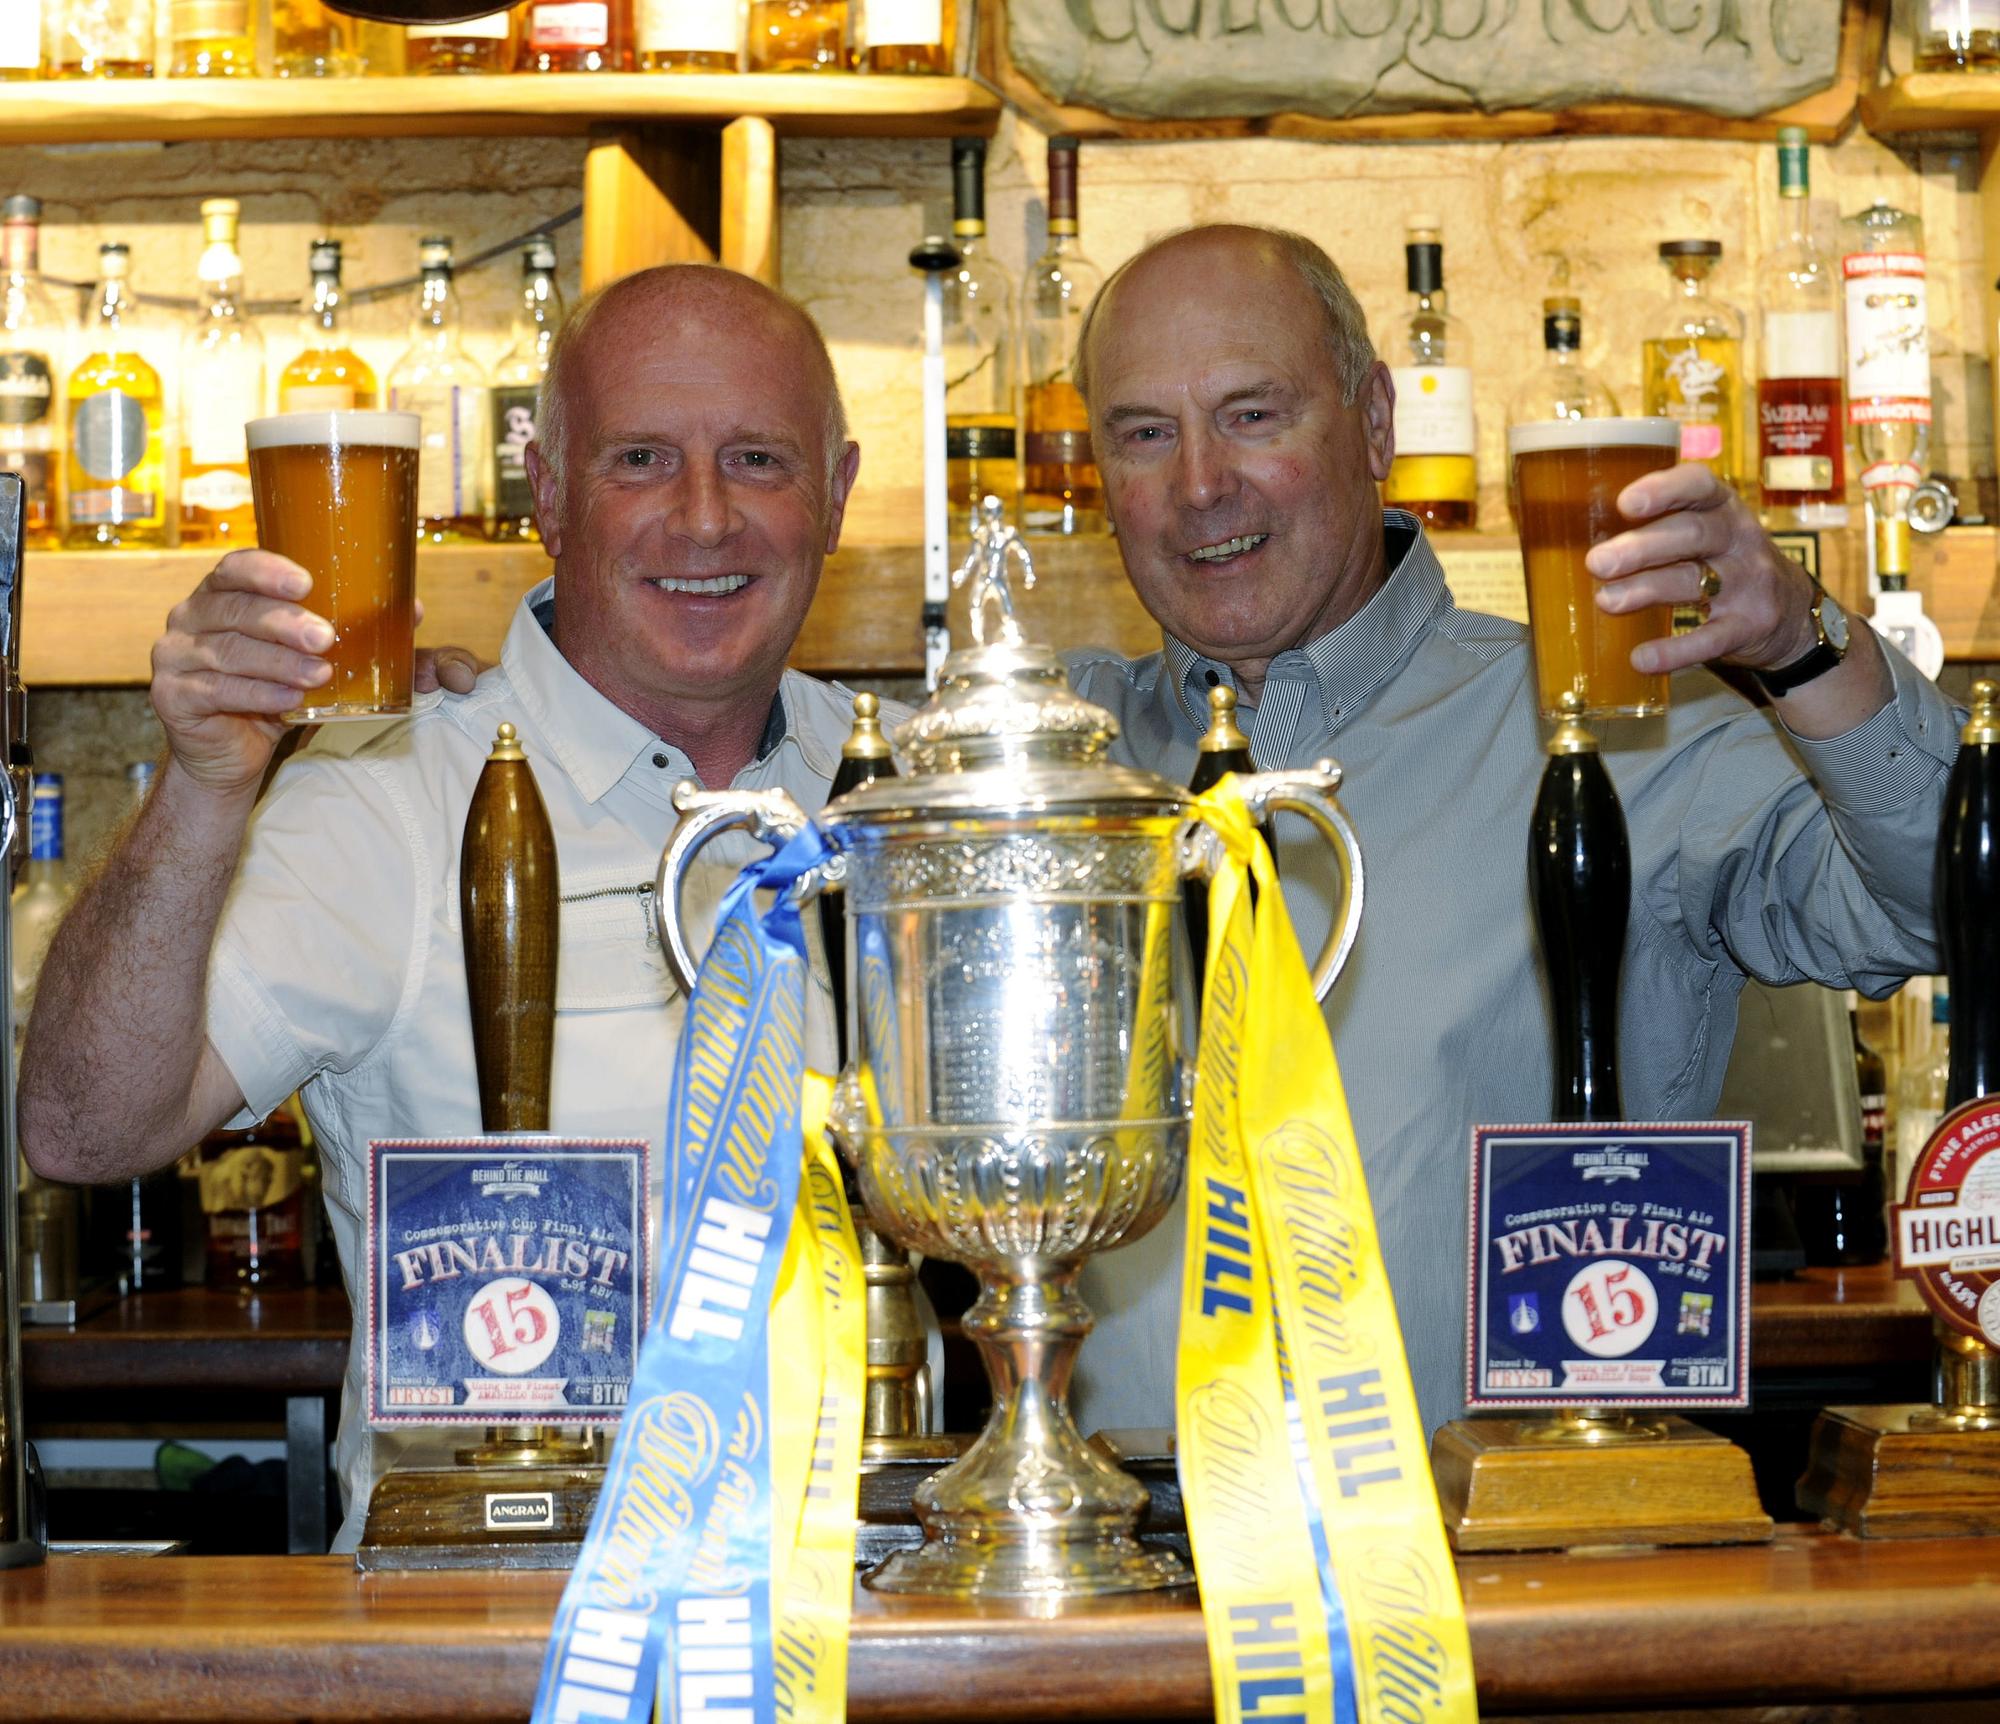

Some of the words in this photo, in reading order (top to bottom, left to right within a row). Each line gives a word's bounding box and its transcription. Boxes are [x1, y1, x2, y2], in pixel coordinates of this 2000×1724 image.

[472, 1169, 504, 1183] BEHIND
[506, 1169, 523, 1182] THE
[524, 1169, 549, 1182] WALL
[1607, 1153, 1624, 1167] THE
[1928, 1137, 1962, 1182] FYNE
[1961, 1113, 2000, 1141] ALES
[512, 1217, 537, 1232] Cup
[542, 1220, 584, 1236] Final
[590, 1227, 615, 1242] Ale
[1611, 1201, 1637, 1216] Cup
[1642, 1202, 1683, 1219] Final
[1688, 1209, 1713, 1225] Ale
[393, 1234, 628, 1292] FINALIST
[669, 1196, 773, 1342] HILL
[1201, 1177, 1254, 1318] HILL
[1258, 1119, 1378, 1366] William
[1493, 1216, 1726, 1275] FINALIST
[470, 1280, 549, 1361] 15
[589, 1284, 613, 1300] ABV
[1569, 1264, 1646, 1343] 15
[391, 1387, 453, 1404] TRYST
[575, 1385, 592, 1395] for
[592, 1384, 628, 1404] BTW
[1489, 1370, 1550, 1387] TRYST
[1688, 1366, 1725, 1386] BTW
[1317, 1368, 1403, 1498] HILL
[492, 1504, 547, 1516] ANGRAM
[1350, 1543, 1449, 1724] Willia
[553, 1607, 650, 1724] HIL
